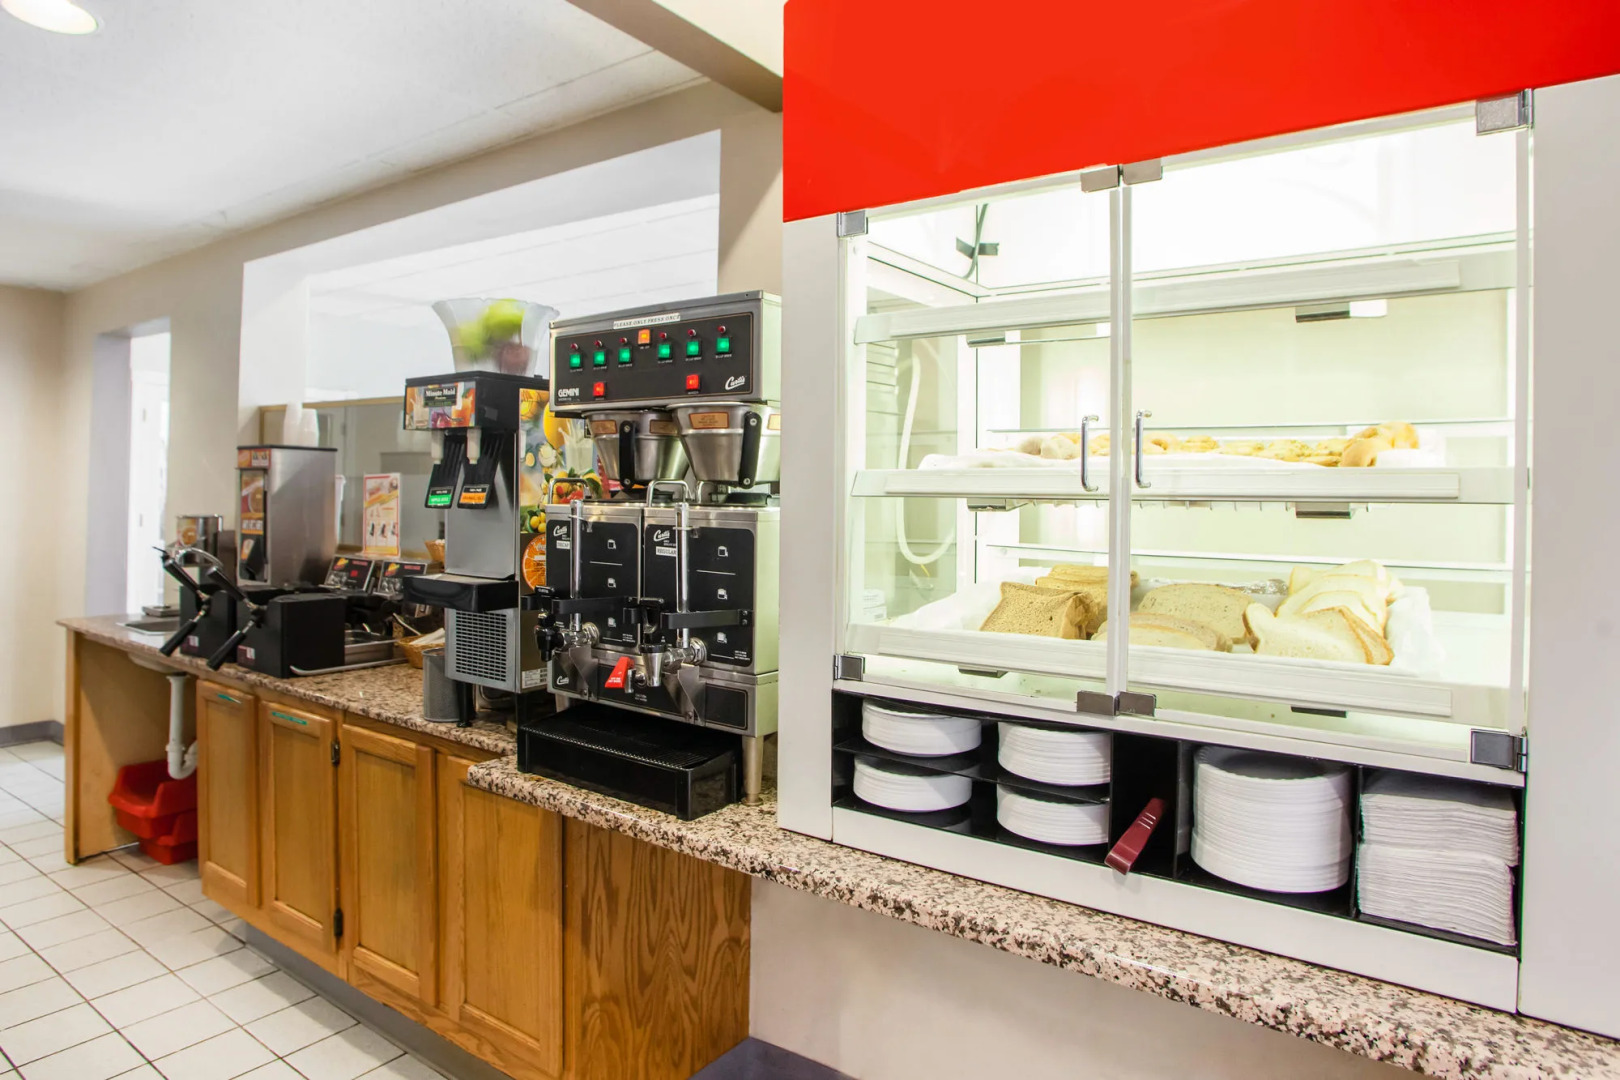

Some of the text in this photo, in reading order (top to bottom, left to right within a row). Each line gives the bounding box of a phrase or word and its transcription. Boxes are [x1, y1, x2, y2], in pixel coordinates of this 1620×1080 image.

[725, 376, 746, 391] Curtis
[443, 387, 456, 396] Maid
[558, 388, 580, 398] GEMINI
[553, 525, 568, 537] Curtis
[653, 529, 670, 542] Curtis
